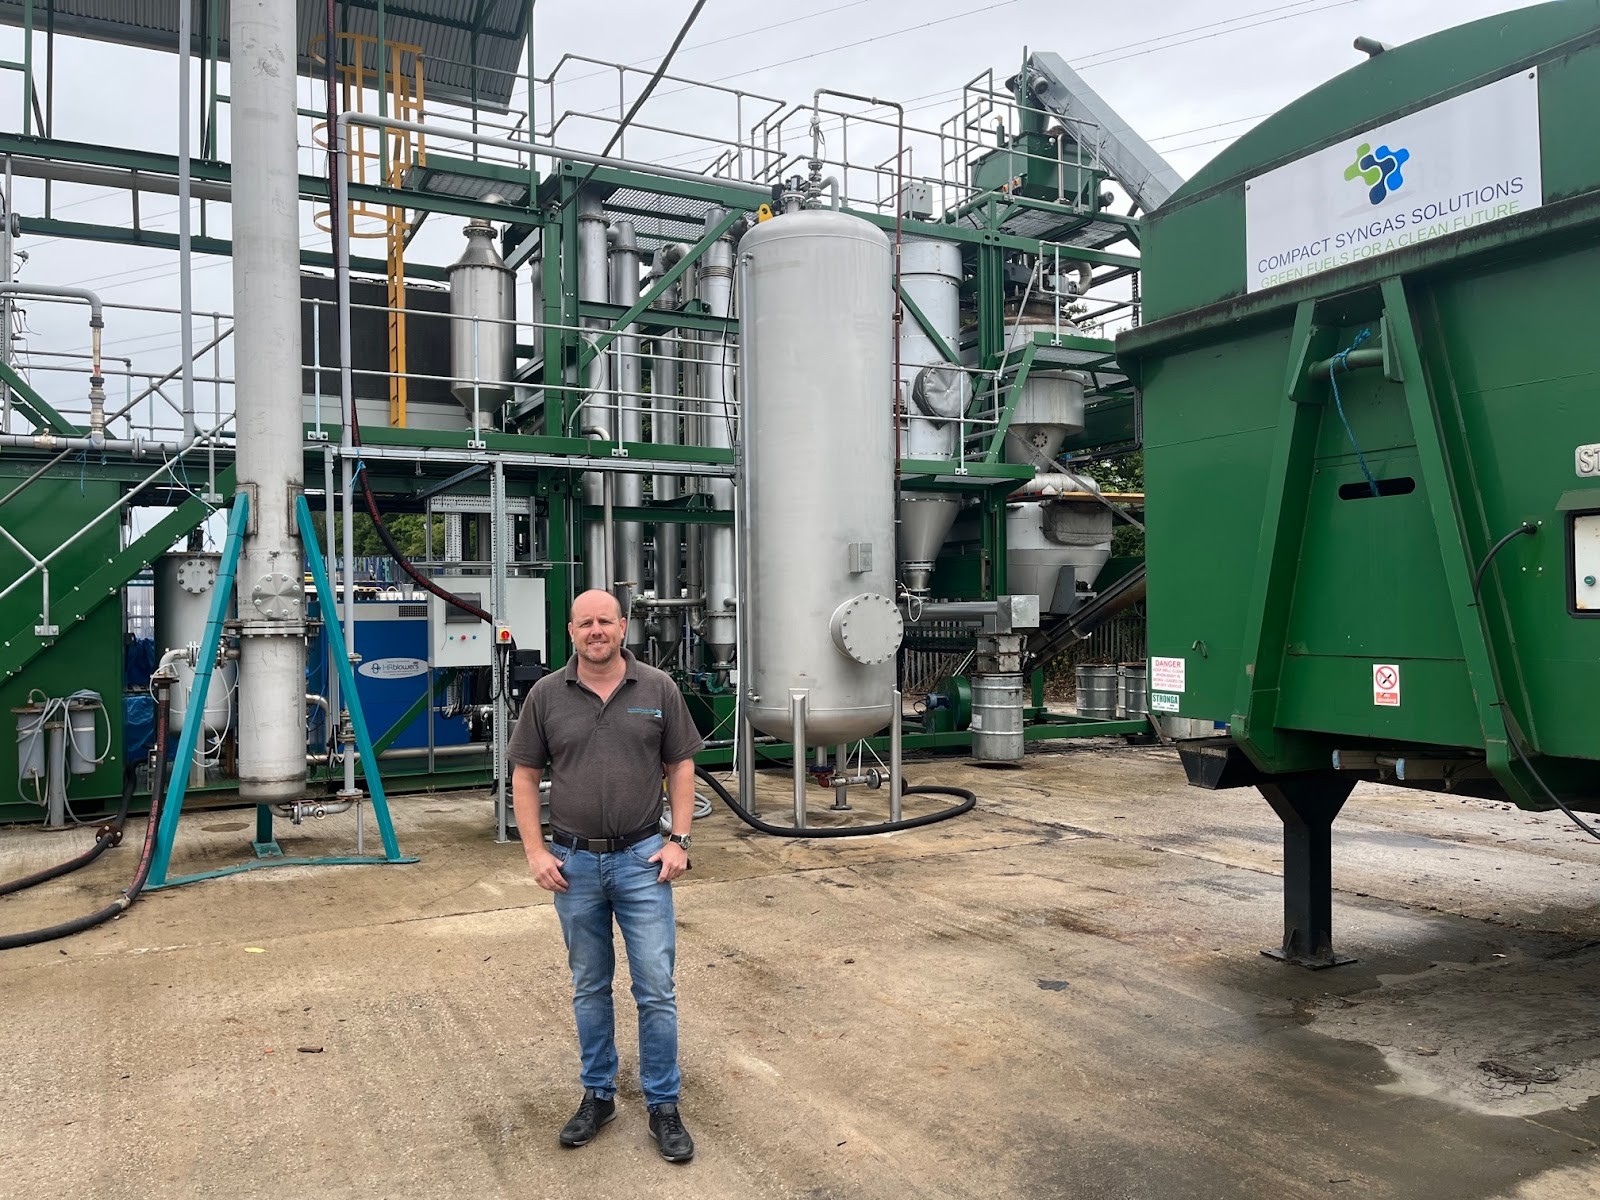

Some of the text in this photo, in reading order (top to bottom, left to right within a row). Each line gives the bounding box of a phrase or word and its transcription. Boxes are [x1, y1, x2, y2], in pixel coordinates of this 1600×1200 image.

[1258, 176, 1524, 273] COMPACT SYNGAS SOLUTIONS
[1261, 200, 1521, 289] GREEN FUELS FOR A CLEAN FUTURE
[1152, 694, 1178, 704] STRONGA
